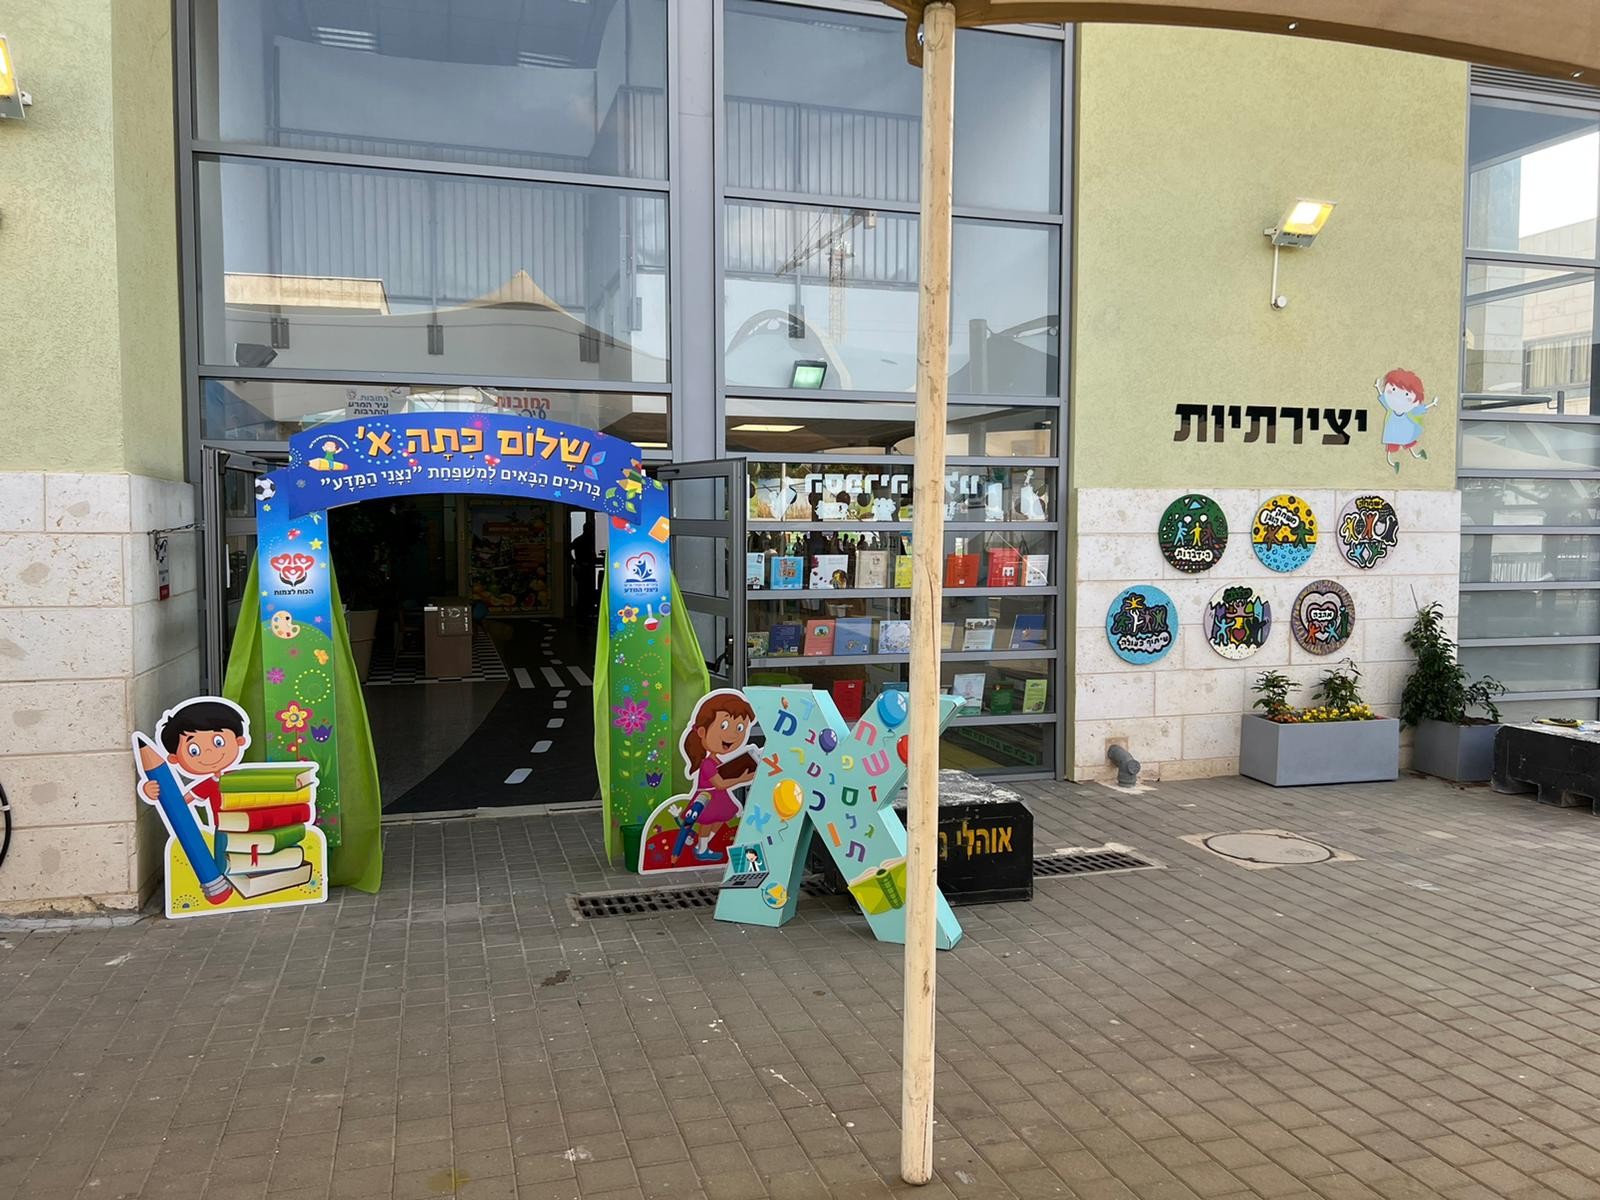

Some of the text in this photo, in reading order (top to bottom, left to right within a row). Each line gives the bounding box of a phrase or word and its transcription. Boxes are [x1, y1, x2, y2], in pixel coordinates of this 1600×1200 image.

[1173, 404, 1368, 445] יצירתיות
[862, 749, 890, 777] ש
[957, 820, 1013, 860] אוהלי
